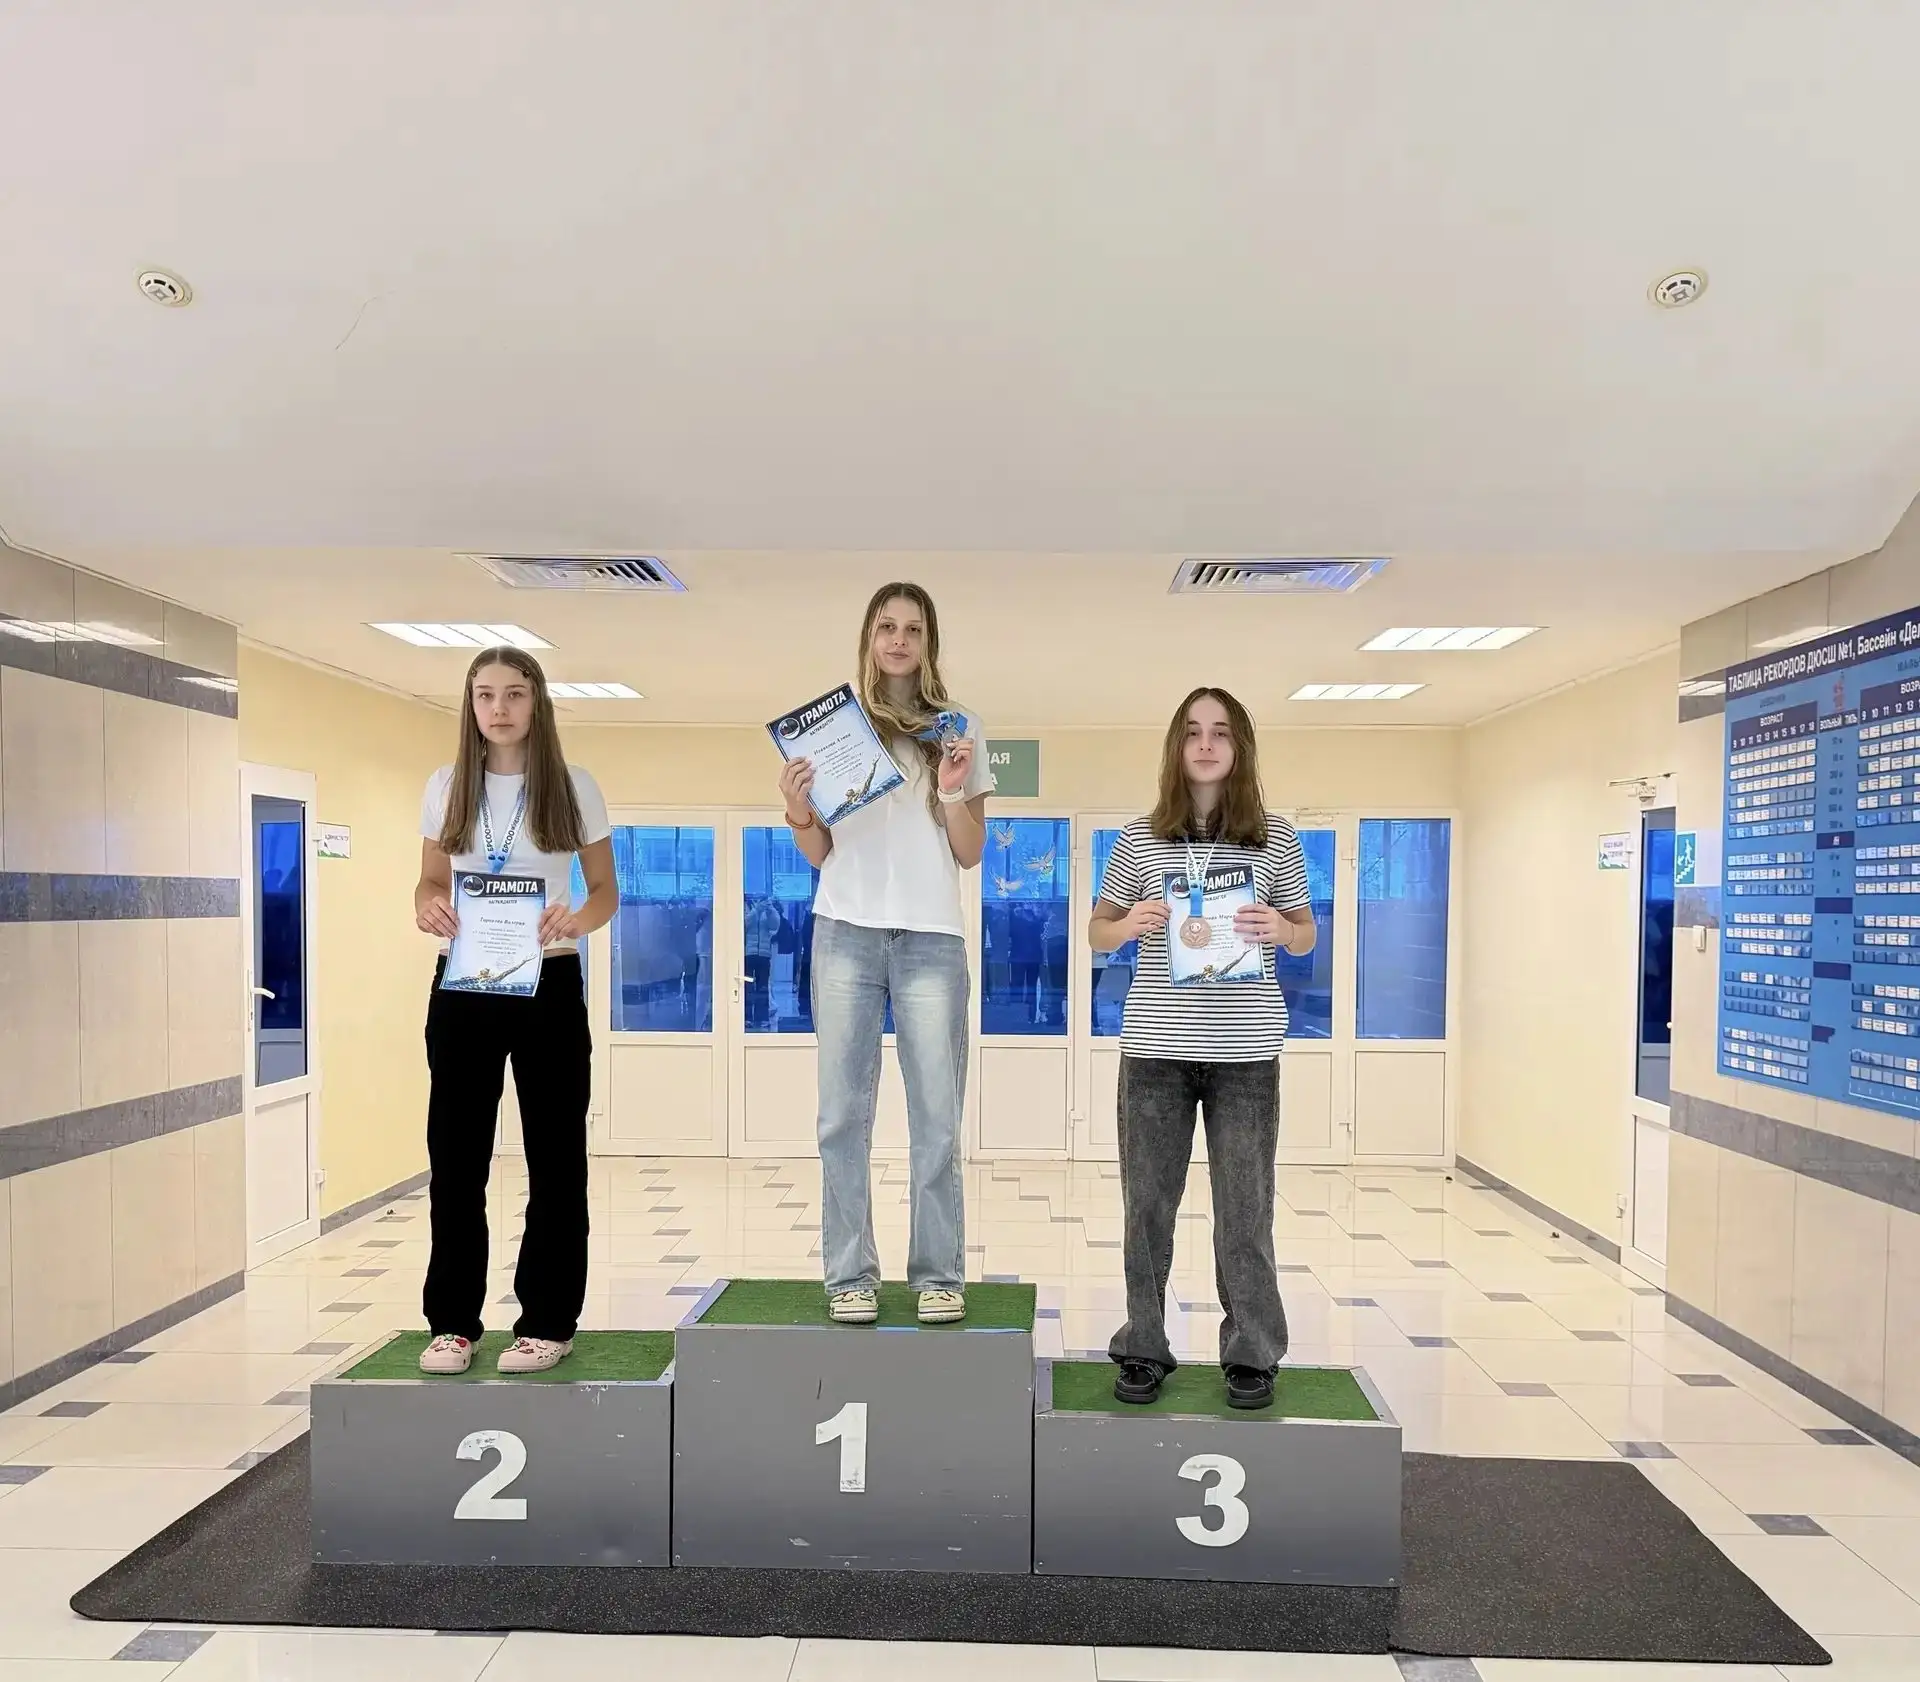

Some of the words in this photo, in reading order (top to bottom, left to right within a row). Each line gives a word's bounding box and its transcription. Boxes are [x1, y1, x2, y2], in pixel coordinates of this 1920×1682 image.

[1728, 669, 1763, 693] ТАБЛИЦА
[1763, 656, 1806, 684] РЕКОРДОВ
[1806, 643, 1836, 674] ДЮСШ
[1838, 640, 1856, 660] №1,
[1857, 627, 1897, 655] Бассейн
[800, 690, 847, 728] ГРАМОТА
[1760, 712, 1784, 727] ВОЗРАСТ
[1862, 710, 1867, 721] 9
[1872, 707, 1879, 719] 10
[1883, 705, 1890, 717] 11
[1895, 702, 1902, 713] 12
[1907, 700, 1914, 711] 13
[1740, 737, 1746, 747] 10
[1748, 736, 1754, 745] 11
[1756, 734, 1762, 743] 12
[1764, 731, 1771, 741] 13
[1781, 728, 1788, 737] 15
[1808, 721, 1815, 731] 18
[501, 830, 515, 853] БРСОО
[486, 881, 538, 894] ГРАМОТА
[815, 1402, 868, 1493] 1
[454, 1429, 528, 1521] 2
[1175, 1453, 1250, 1548] 3
